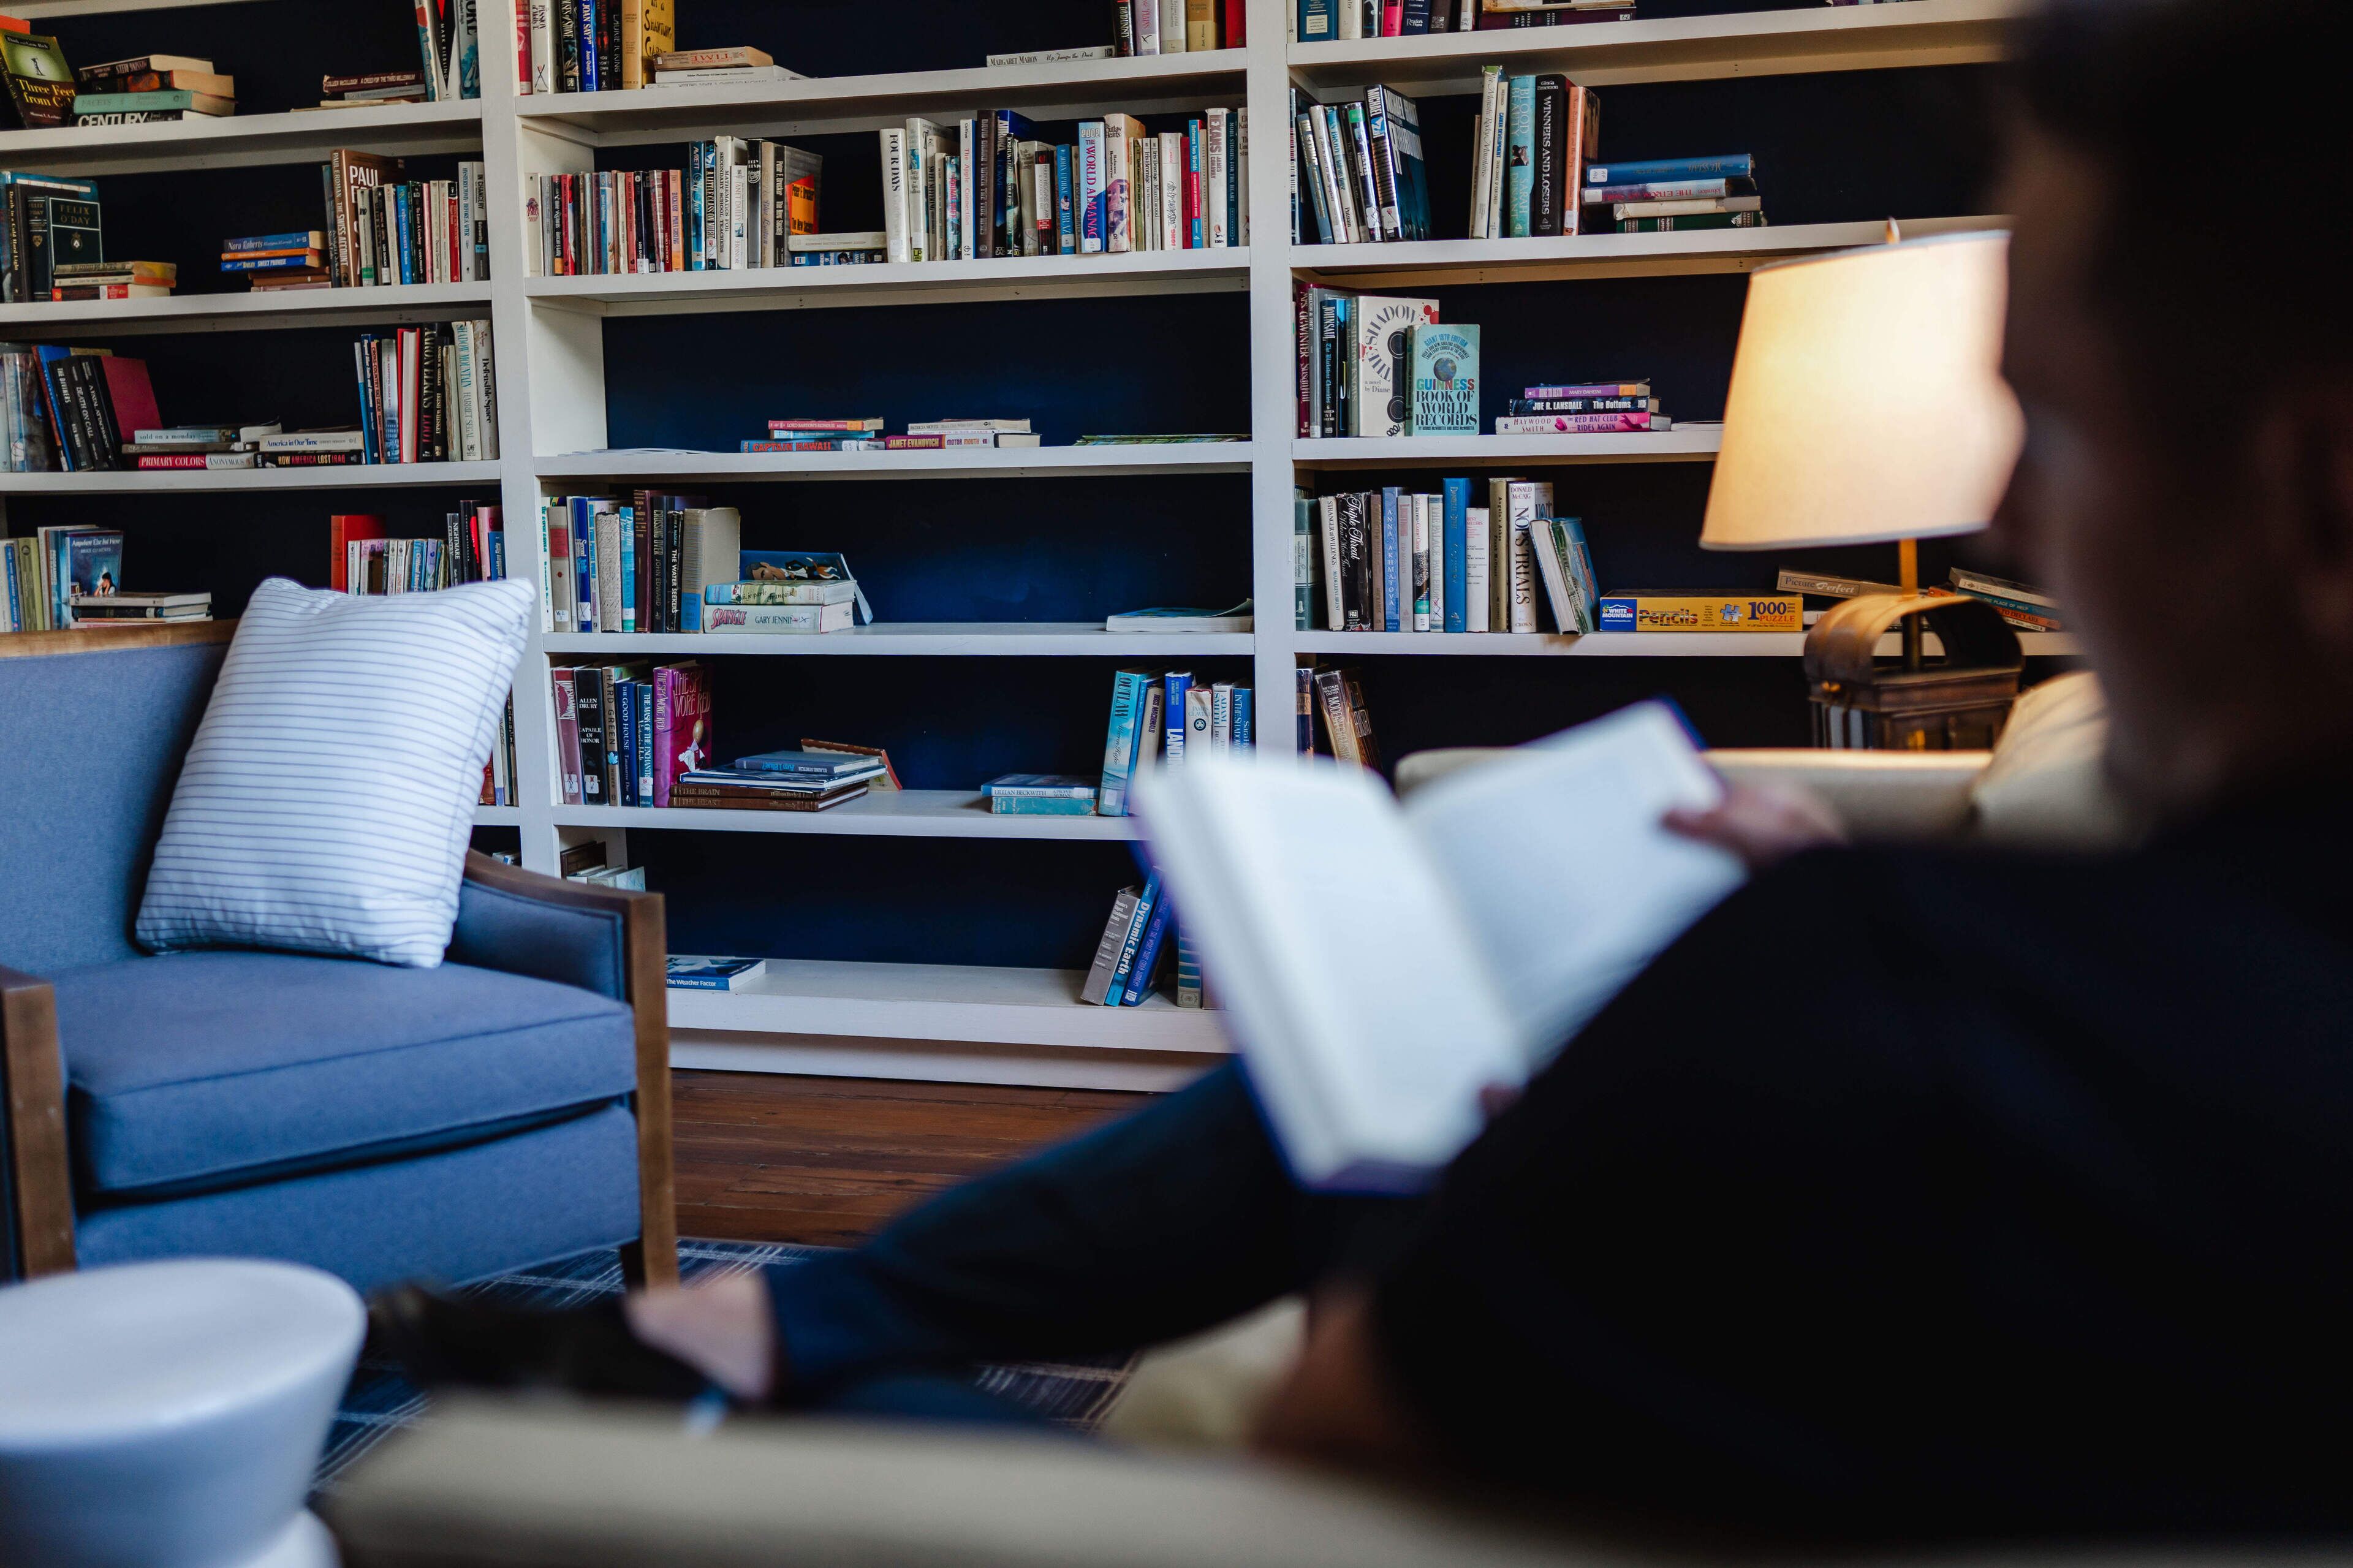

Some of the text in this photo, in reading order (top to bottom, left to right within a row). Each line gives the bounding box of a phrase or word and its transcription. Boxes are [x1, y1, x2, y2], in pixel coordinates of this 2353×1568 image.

[583, 3, 591, 21] JOAN
[691, 53, 732, 62] TIME
[990, 53, 1055, 67] MARGARET Up
[16, 78, 50, 97] Three
[23, 91, 51, 107] from
[1367, 87, 1382, 117] MICHAEL
[78, 112, 149, 127] CENTURY
[1510, 88, 1520, 137] BEAUTY
[1519, 89, 1530, 134] BLOOD
[1209, 113, 1223, 153] TEXANS
[890, 134, 899, 164] FOUR
[1480, 137, 1491, 177] Mountains
[1540, 96, 1552, 216] WINNERS AND LOSERS
[891, 165, 901, 192] DAYS
[1085, 145, 1099, 239] WORLD ALMANAC
[1519, 178, 1528, 214] SARAH
[337, 214, 346, 236] SWISS
[227, 239, 263, 251] Nora Roberts
[339, 237, 348, 266] ACCOUNT
[424, 327, 437, 365] AARON
[460, 355, 471, 388] MOUNTAIN
[482, 358, 492, 423] Defensible Space
[1416, 377, 1475, 390] GUINNESS
[463, 392, 472, 418] HARRIET
[1416, 390, 1475, 403] BOOK OF
[1533, 401, 1544, 410] JOE
[1553, 400, 1583, 409] LANSDALE
[1593, 400, 1604, 409] The
[1605, 400, 1631, 409] Bottoms
[76, 387, 93, 437] DEATH CALL
[1422, 402, 1468, 414] WORLD
[1415, 414, 1477, 426] RECORDS
[267, 439, 288, 447] America
[752, 441, 832, 452] CAPTAIN HAWAII
[888, 439, 907, 449] JANET
[907, 437, 939, 448] EVANOVICH
[140, 455, 205, 466] PRIMARY COLORS
[278, 454, 332, 465] HOW LOST
[653, 509, 663, 539] CROSSING
[1343, 496, 1364, 560] Triple Threat
[654, 539, 664, 555] OVER
[1515, 551, 1530, 605] TRIALS
[1785, 576, 1855, 593] Picture Perfect
[710, 608, 748, 630] SPANGLE
[1639, 607, 1698, 626] Pencils
[1748, 601, 1787, 620] 1000
[697, 692, 711, 716] RED
[1114, 676, 1132, 720] OUTLAW
[1148, 694, 1161, 733] ROSS MACDONALD
[645, 723, 651, 732] OF
[1117, 901, 1150, 975] Dynamic Earth
